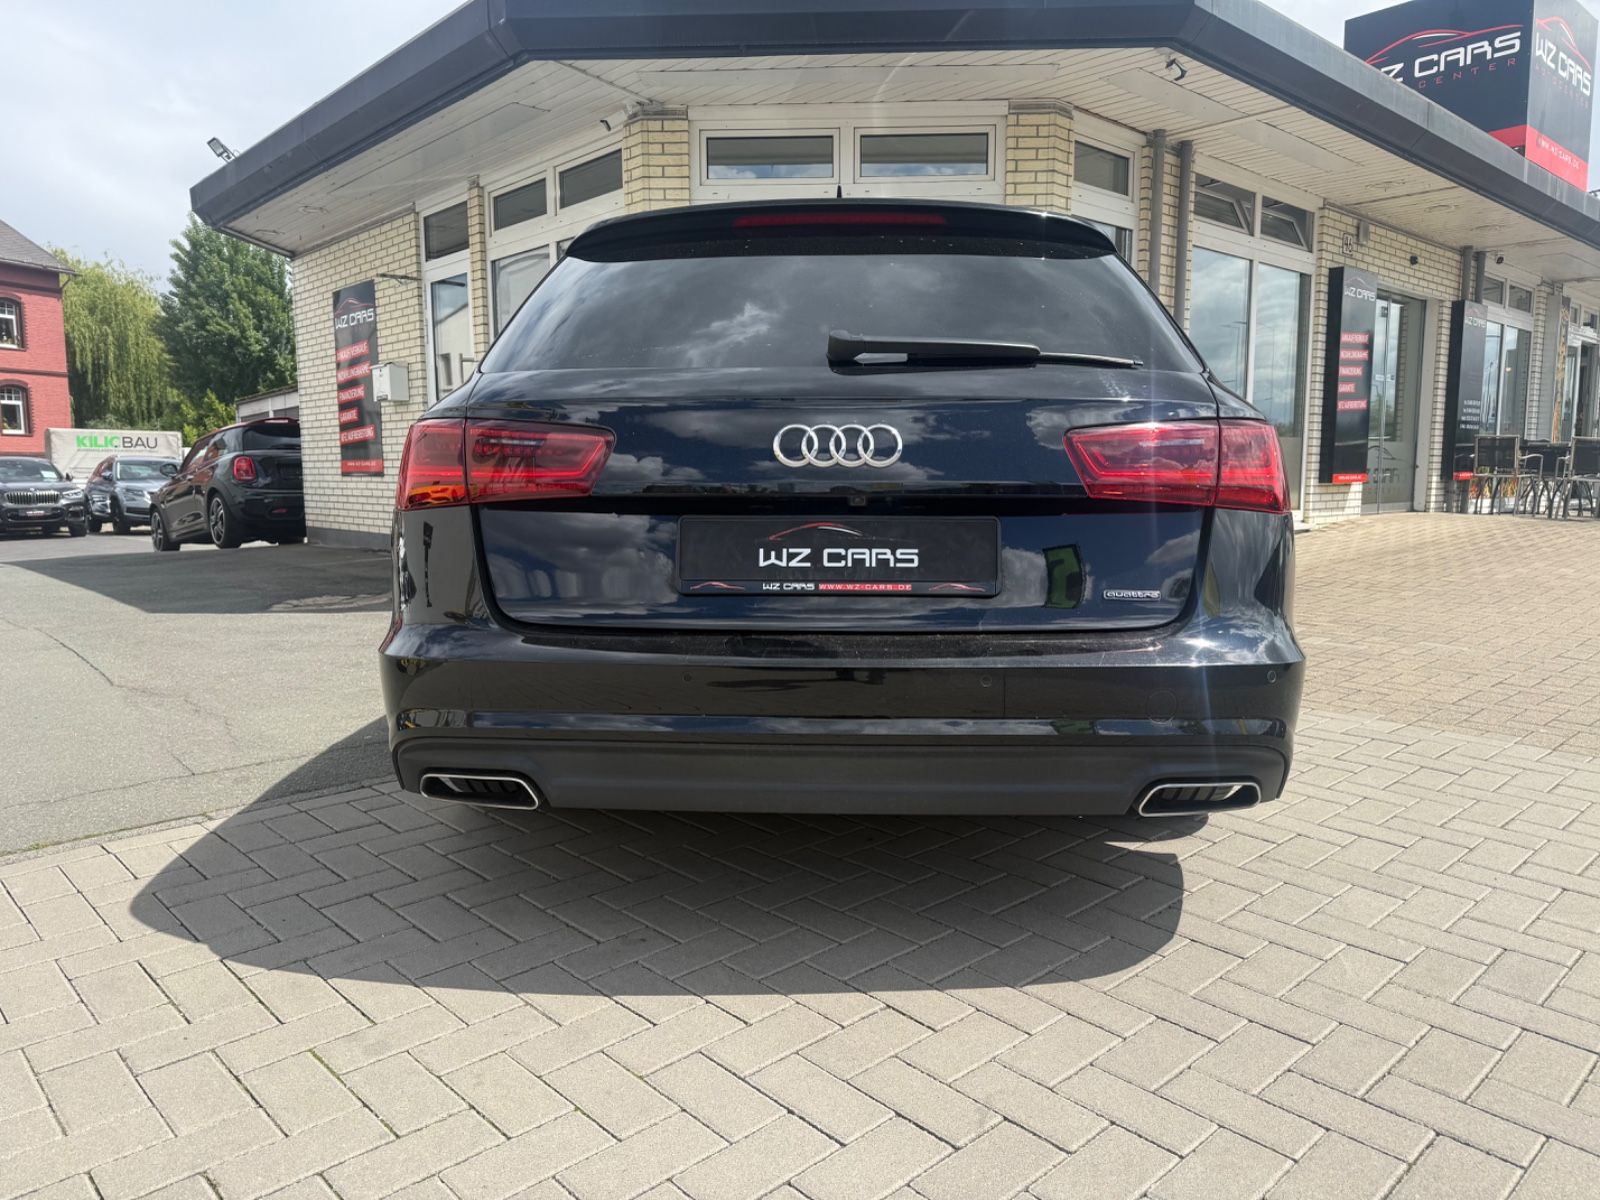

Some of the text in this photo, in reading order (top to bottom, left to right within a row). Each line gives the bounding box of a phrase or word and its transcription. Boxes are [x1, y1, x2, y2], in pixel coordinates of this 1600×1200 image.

[1381, 31, 1521, 82] Z CARS
[1535, 31, 1592, 97] WZ CARS
[1418, 57, 1516, 89] CENTER
[335, 308, 374, 330] WZ CARS
[122, 436, 158, 449] BAU
[759, 548, 919, 567] WZ CARS
[762, 582, 780, 590] WZ
[783, 582, 815, 590] CARS
